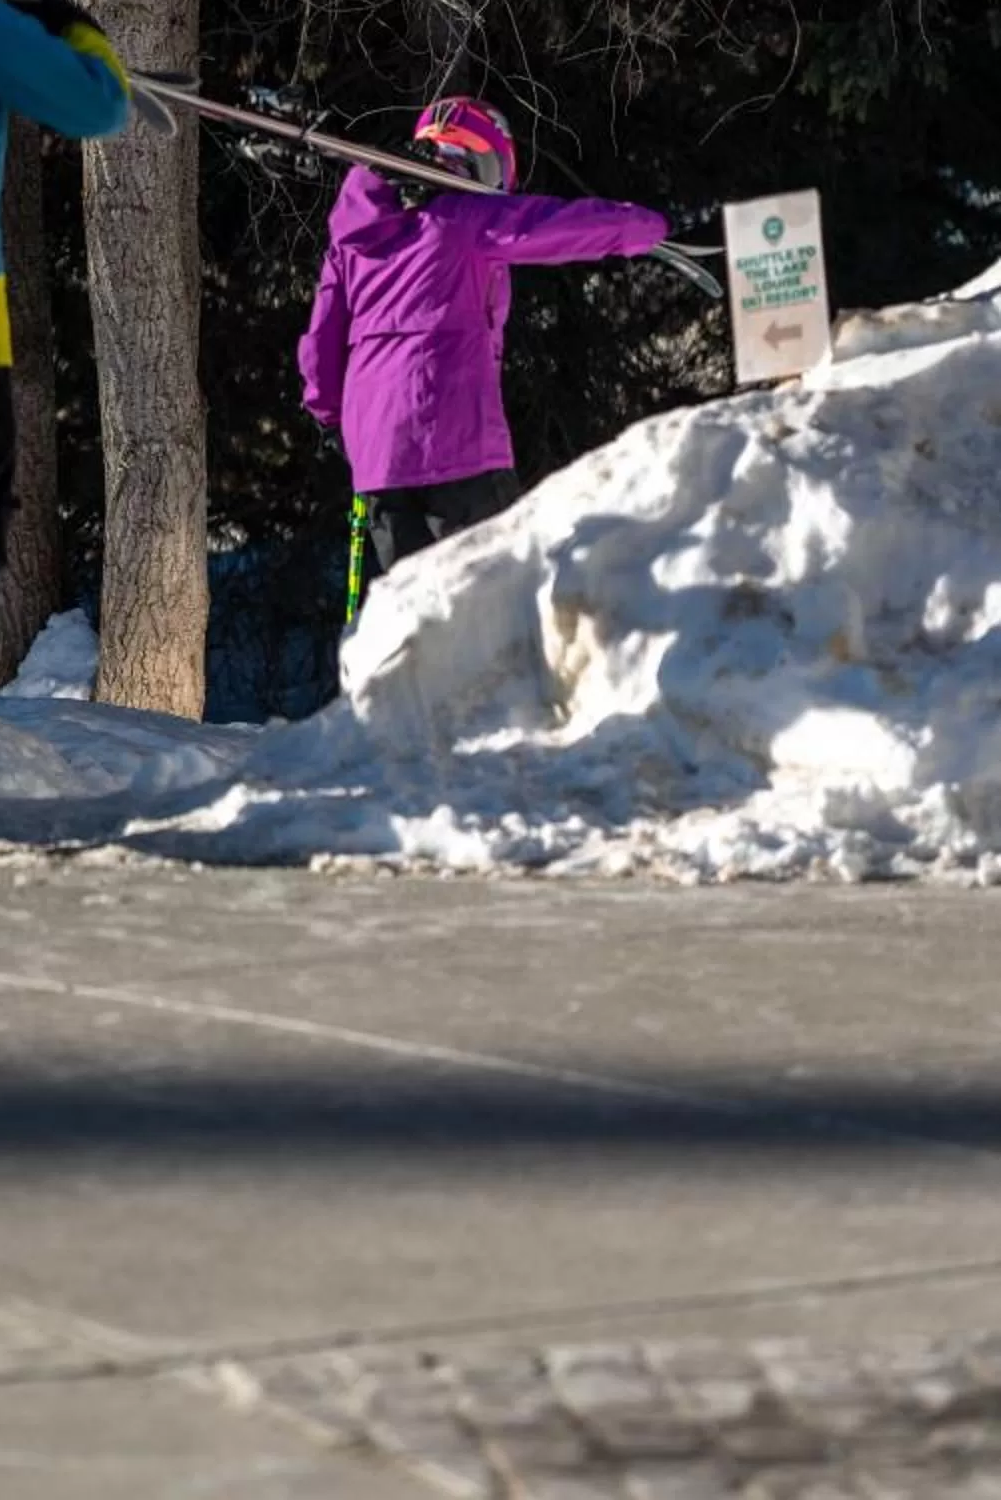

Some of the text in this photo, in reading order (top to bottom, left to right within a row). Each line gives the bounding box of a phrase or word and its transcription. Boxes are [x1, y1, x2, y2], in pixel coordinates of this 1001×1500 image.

[736, 245, 816, 269] SHUTTLE TO
[745, 260, 808, 280] THE LAKE
[753, 275, 801, 292] LOUISE
[742, 285, 817, 309] SKI RESORT
